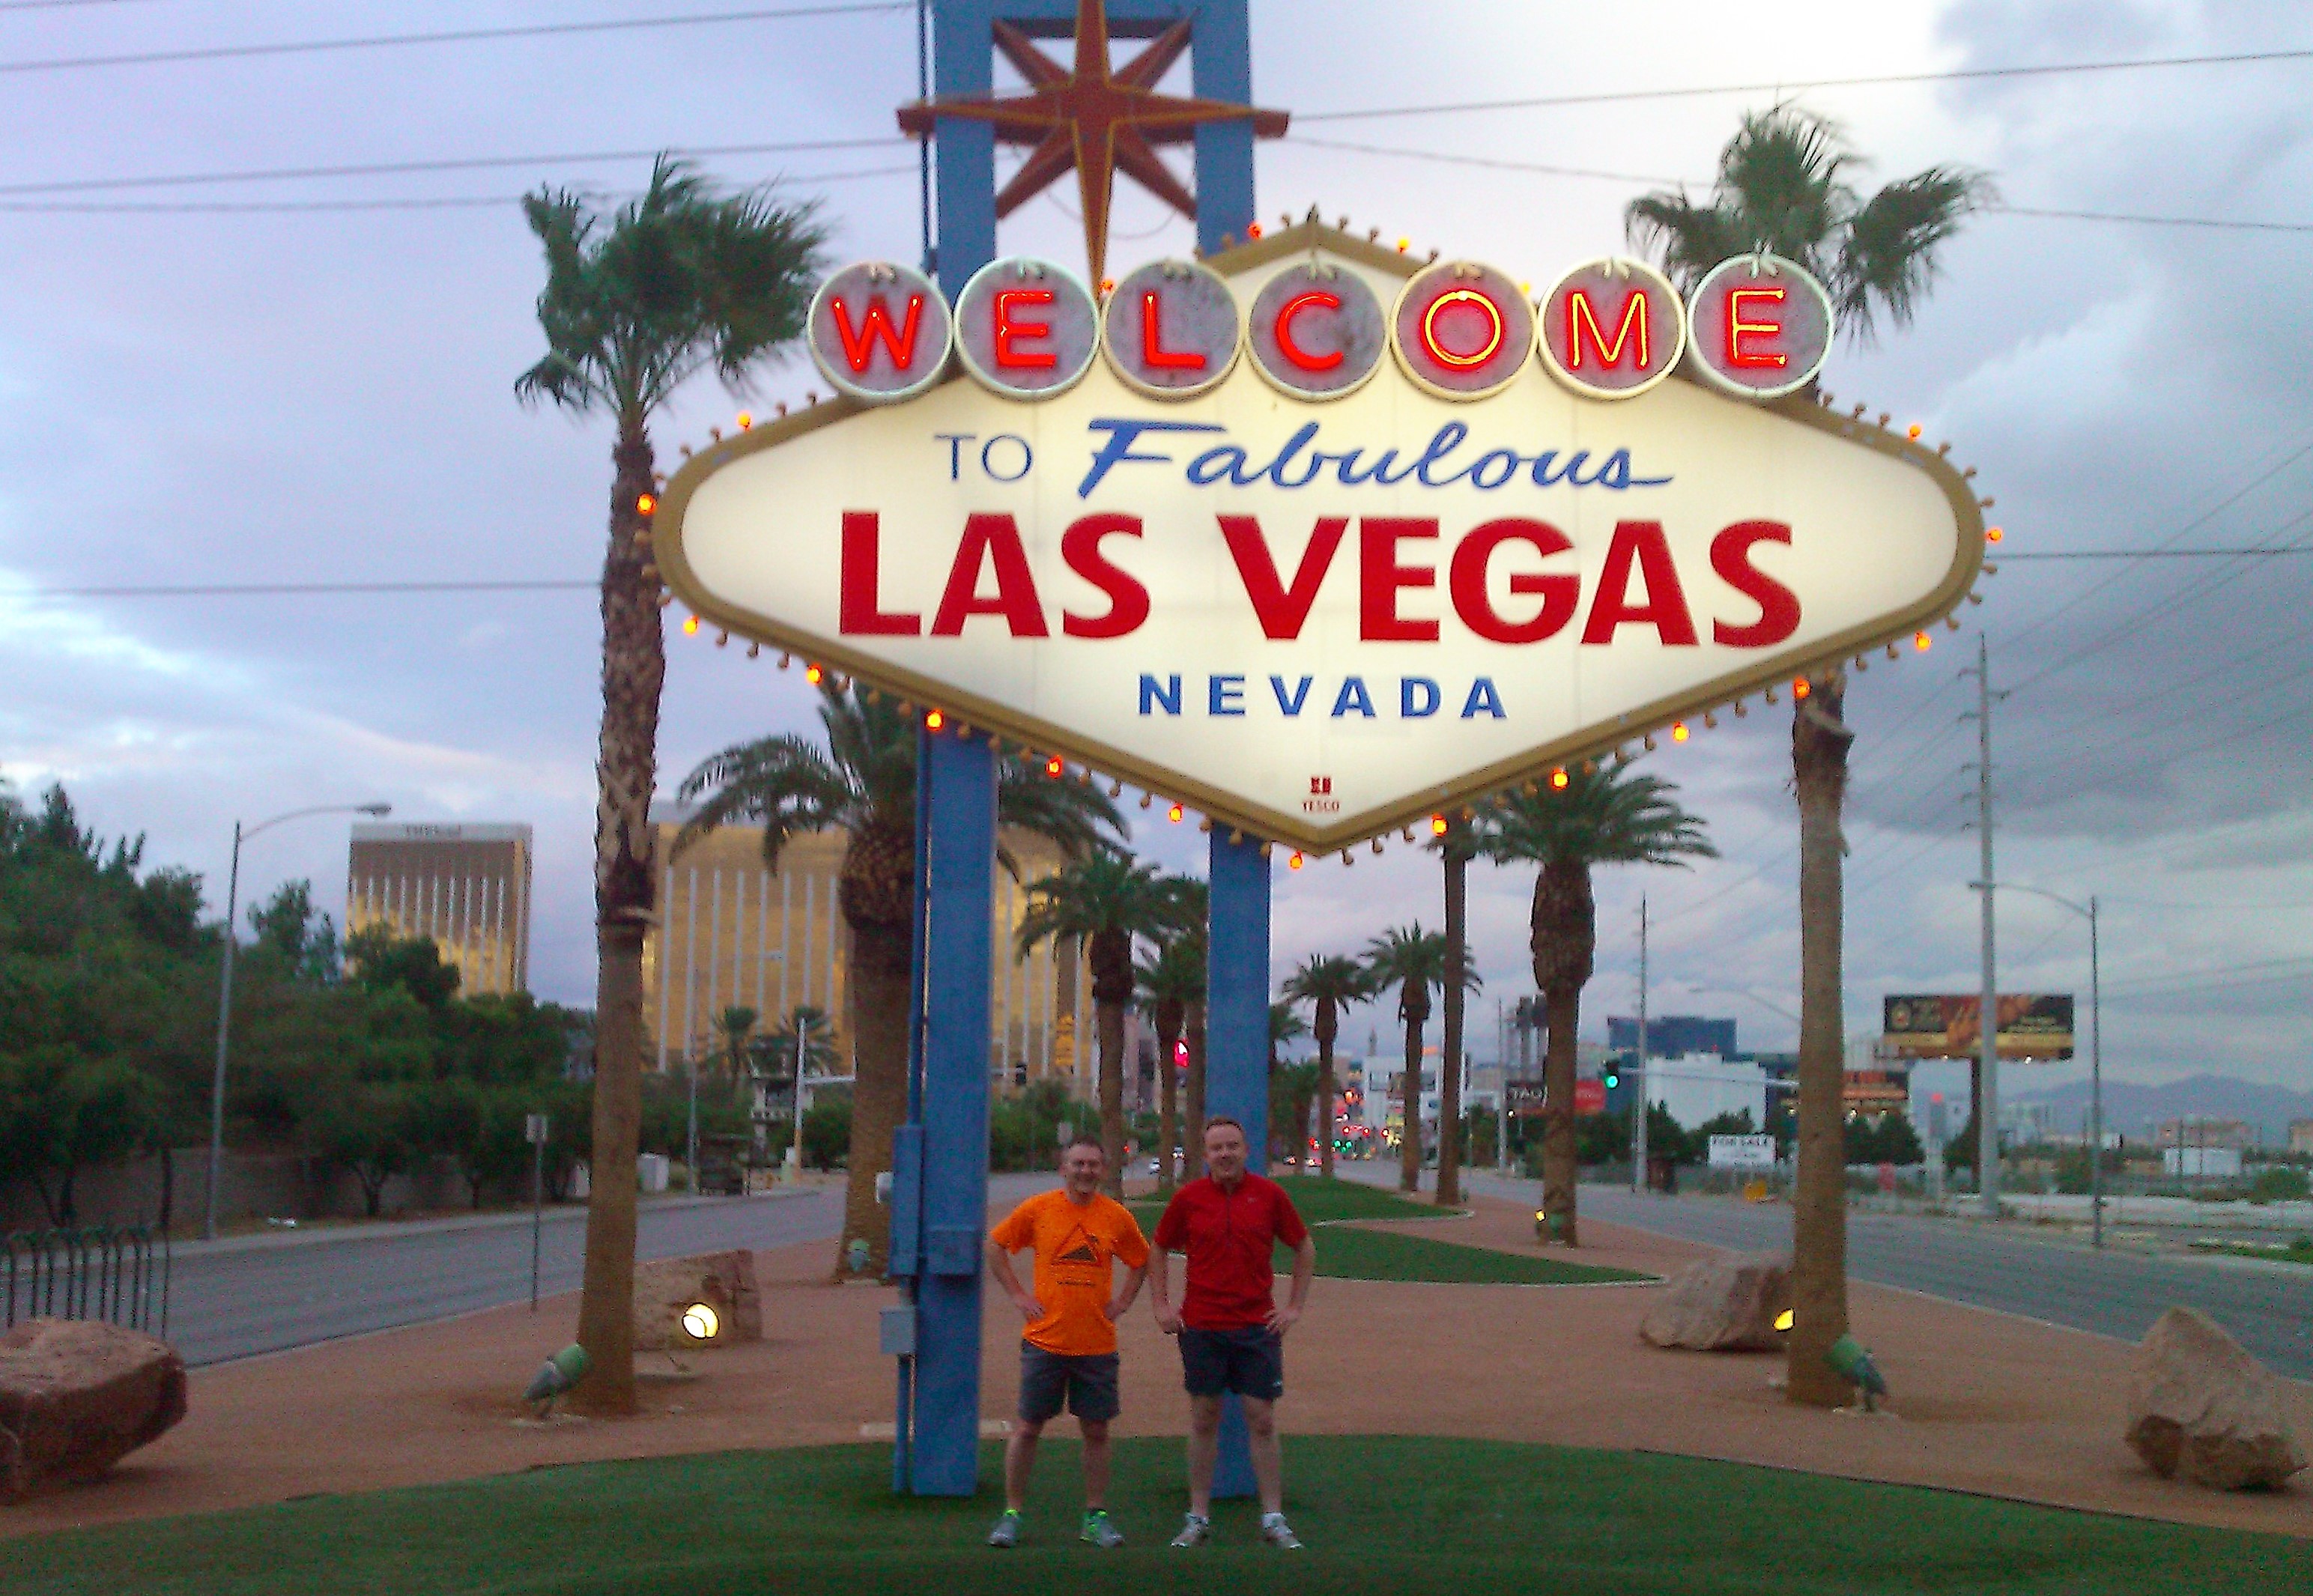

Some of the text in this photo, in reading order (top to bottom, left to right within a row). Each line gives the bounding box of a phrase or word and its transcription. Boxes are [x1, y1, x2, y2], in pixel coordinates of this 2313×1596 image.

[828, 286, 1789, 376] WELCOME
[934, 418, 1675, 499] TO Fabulous
[840, 512, 1801, 649] LAS VEGAS
[1139, 674, 1505, 718] NEVADA
